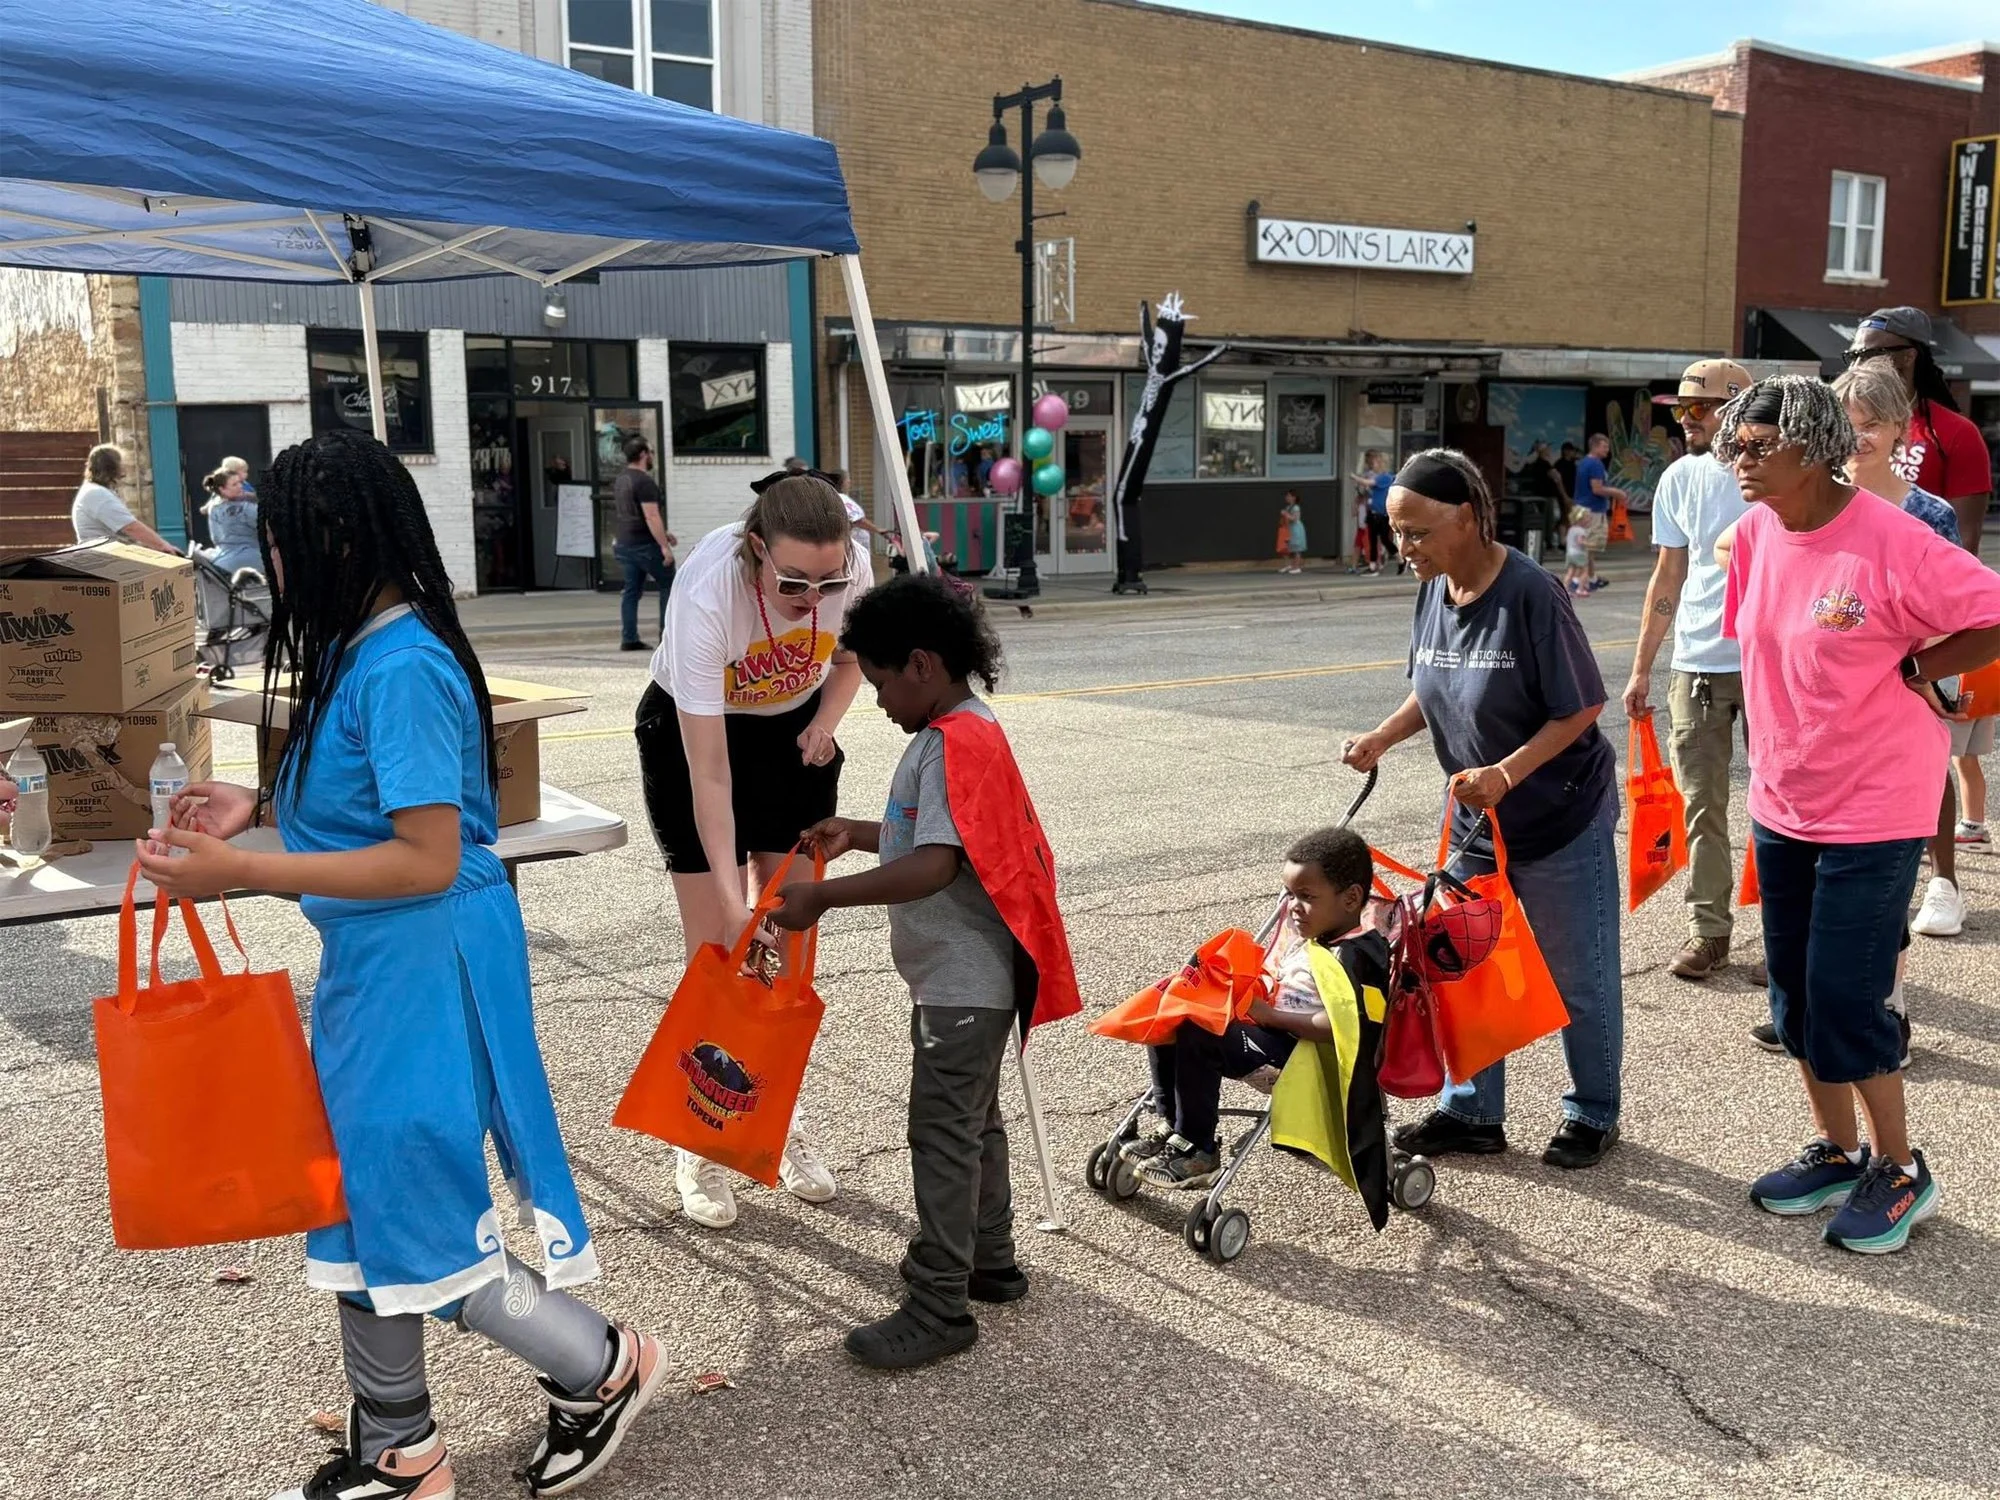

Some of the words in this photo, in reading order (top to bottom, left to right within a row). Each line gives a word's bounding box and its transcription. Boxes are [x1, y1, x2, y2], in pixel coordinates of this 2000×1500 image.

[1957, 153, 1978, 250] WHEEL
[1296, 227, 1381, 262] ODIN'S
[1386, 234, 1440, 265] LAIR
[1970, 184, 1989, 298] BARREL
[327, 374, 349, 383] Home
[350, 374, 360, 383] of
[531, 375, 572, 395] 917
[897, 407, 940, 453] Toot
[950, 412, 1008, 456] Sweet
[44, 649, 82, 663] minis
[1469, 649, 1516, 661] NATIONAL
[1501, 660, 1515, 669] DAY
[17, 668, 55, 677] TRANSFER
[26, 676, 46, 684] CASE
[34, 715, 58, 728] ACK
[127, 715, 158, 726] 10996
[64, 798, 102, 807] TRANSFER
[74, 806, 94, 814] CASE
[686, 1094, 724, 1132] TOPEKA
